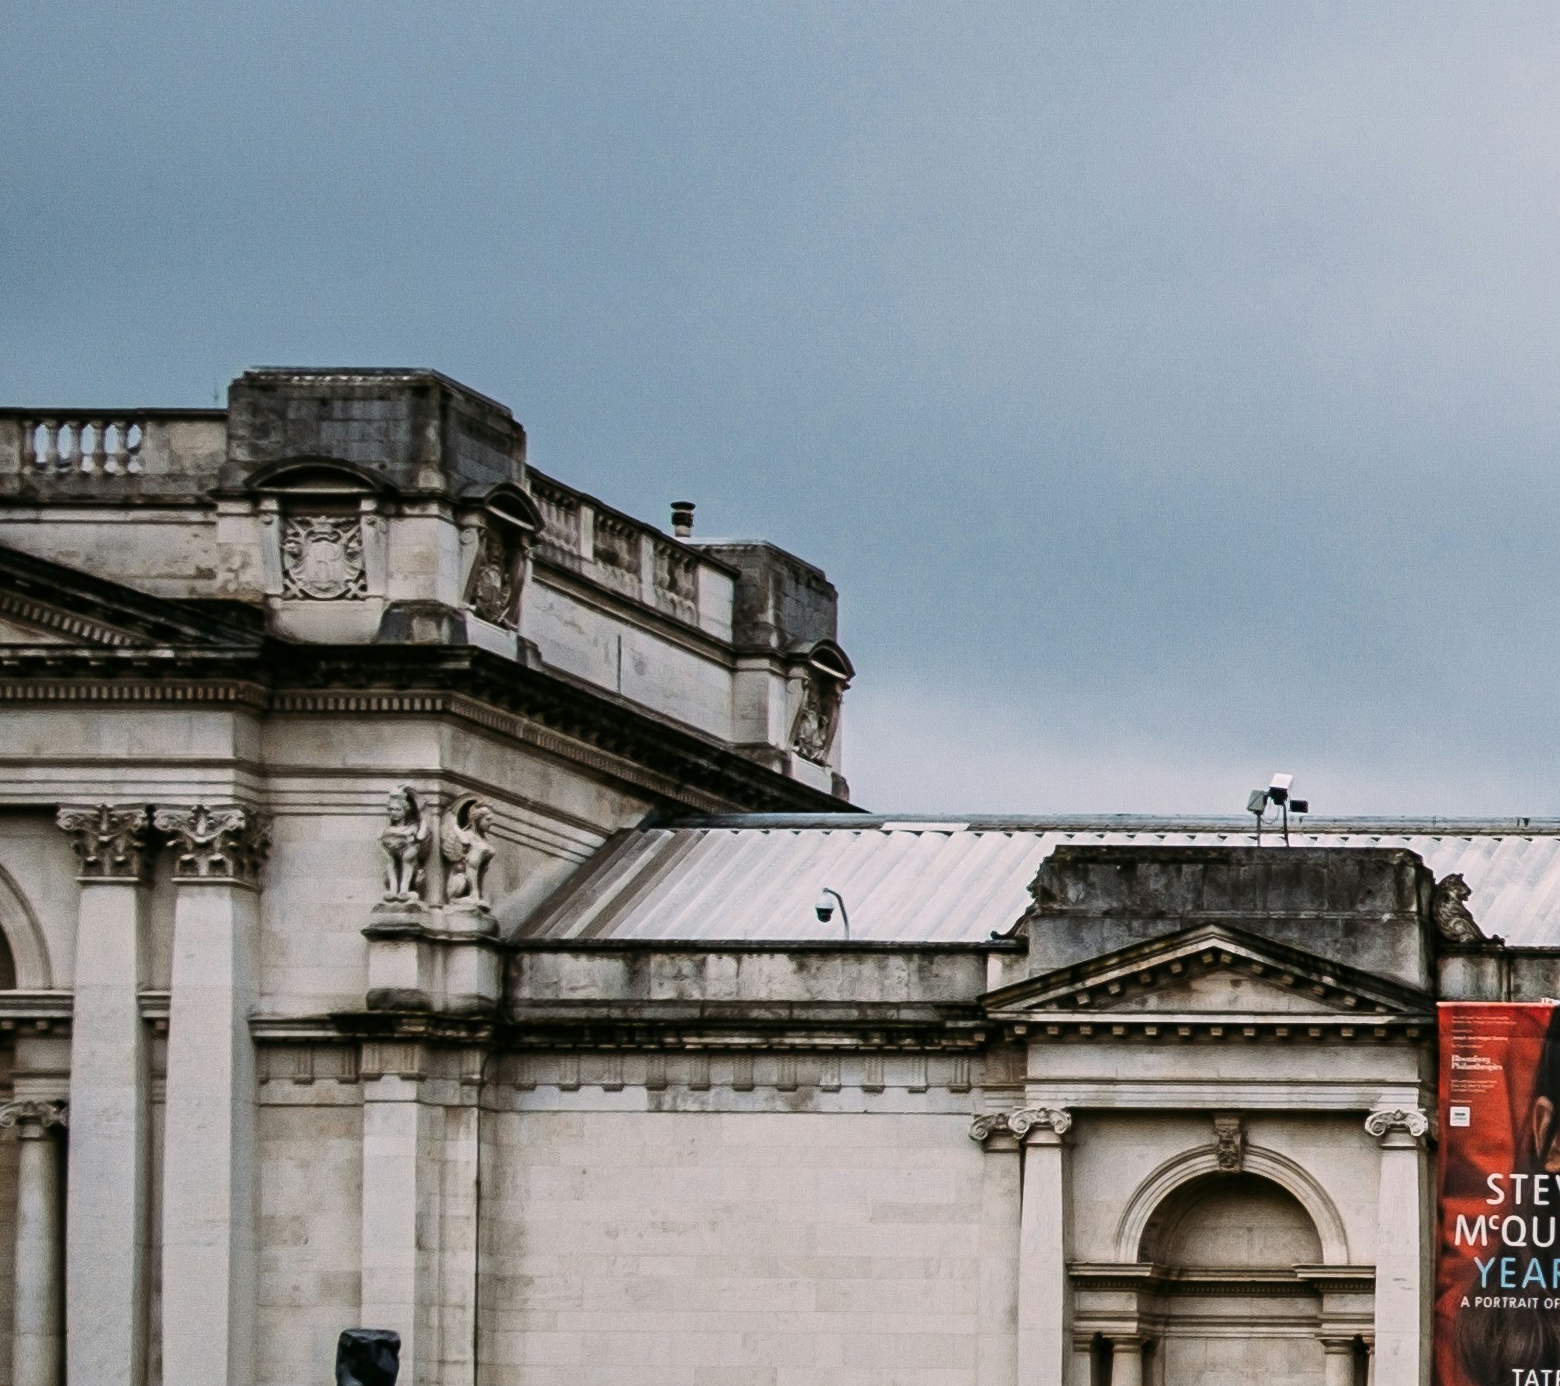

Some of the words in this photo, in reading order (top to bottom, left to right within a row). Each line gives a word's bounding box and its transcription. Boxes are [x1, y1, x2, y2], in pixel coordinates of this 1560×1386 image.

[1460, 1296, 1470, 1308] A
[1474, 1297, 1539, 1309] PORTRAIT
[1543, 1298, 1560, 1310] OF
